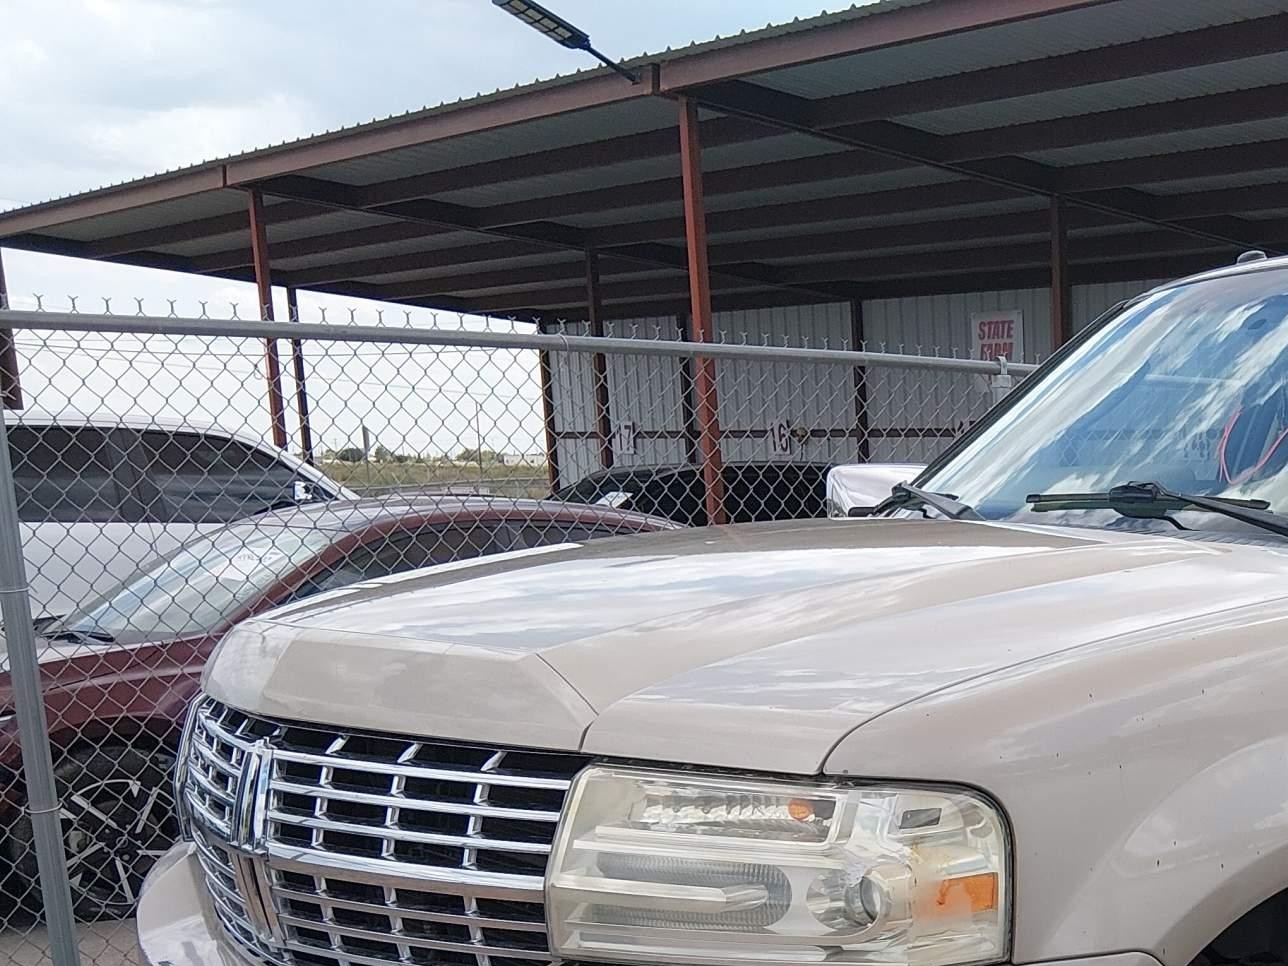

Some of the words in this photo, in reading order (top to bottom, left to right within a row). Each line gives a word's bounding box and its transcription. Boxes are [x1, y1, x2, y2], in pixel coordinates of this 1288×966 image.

[978, 320, 1014, 341] STATE
[616, 423, 632, 451] 17
[769, 422, 788, 452] 16
